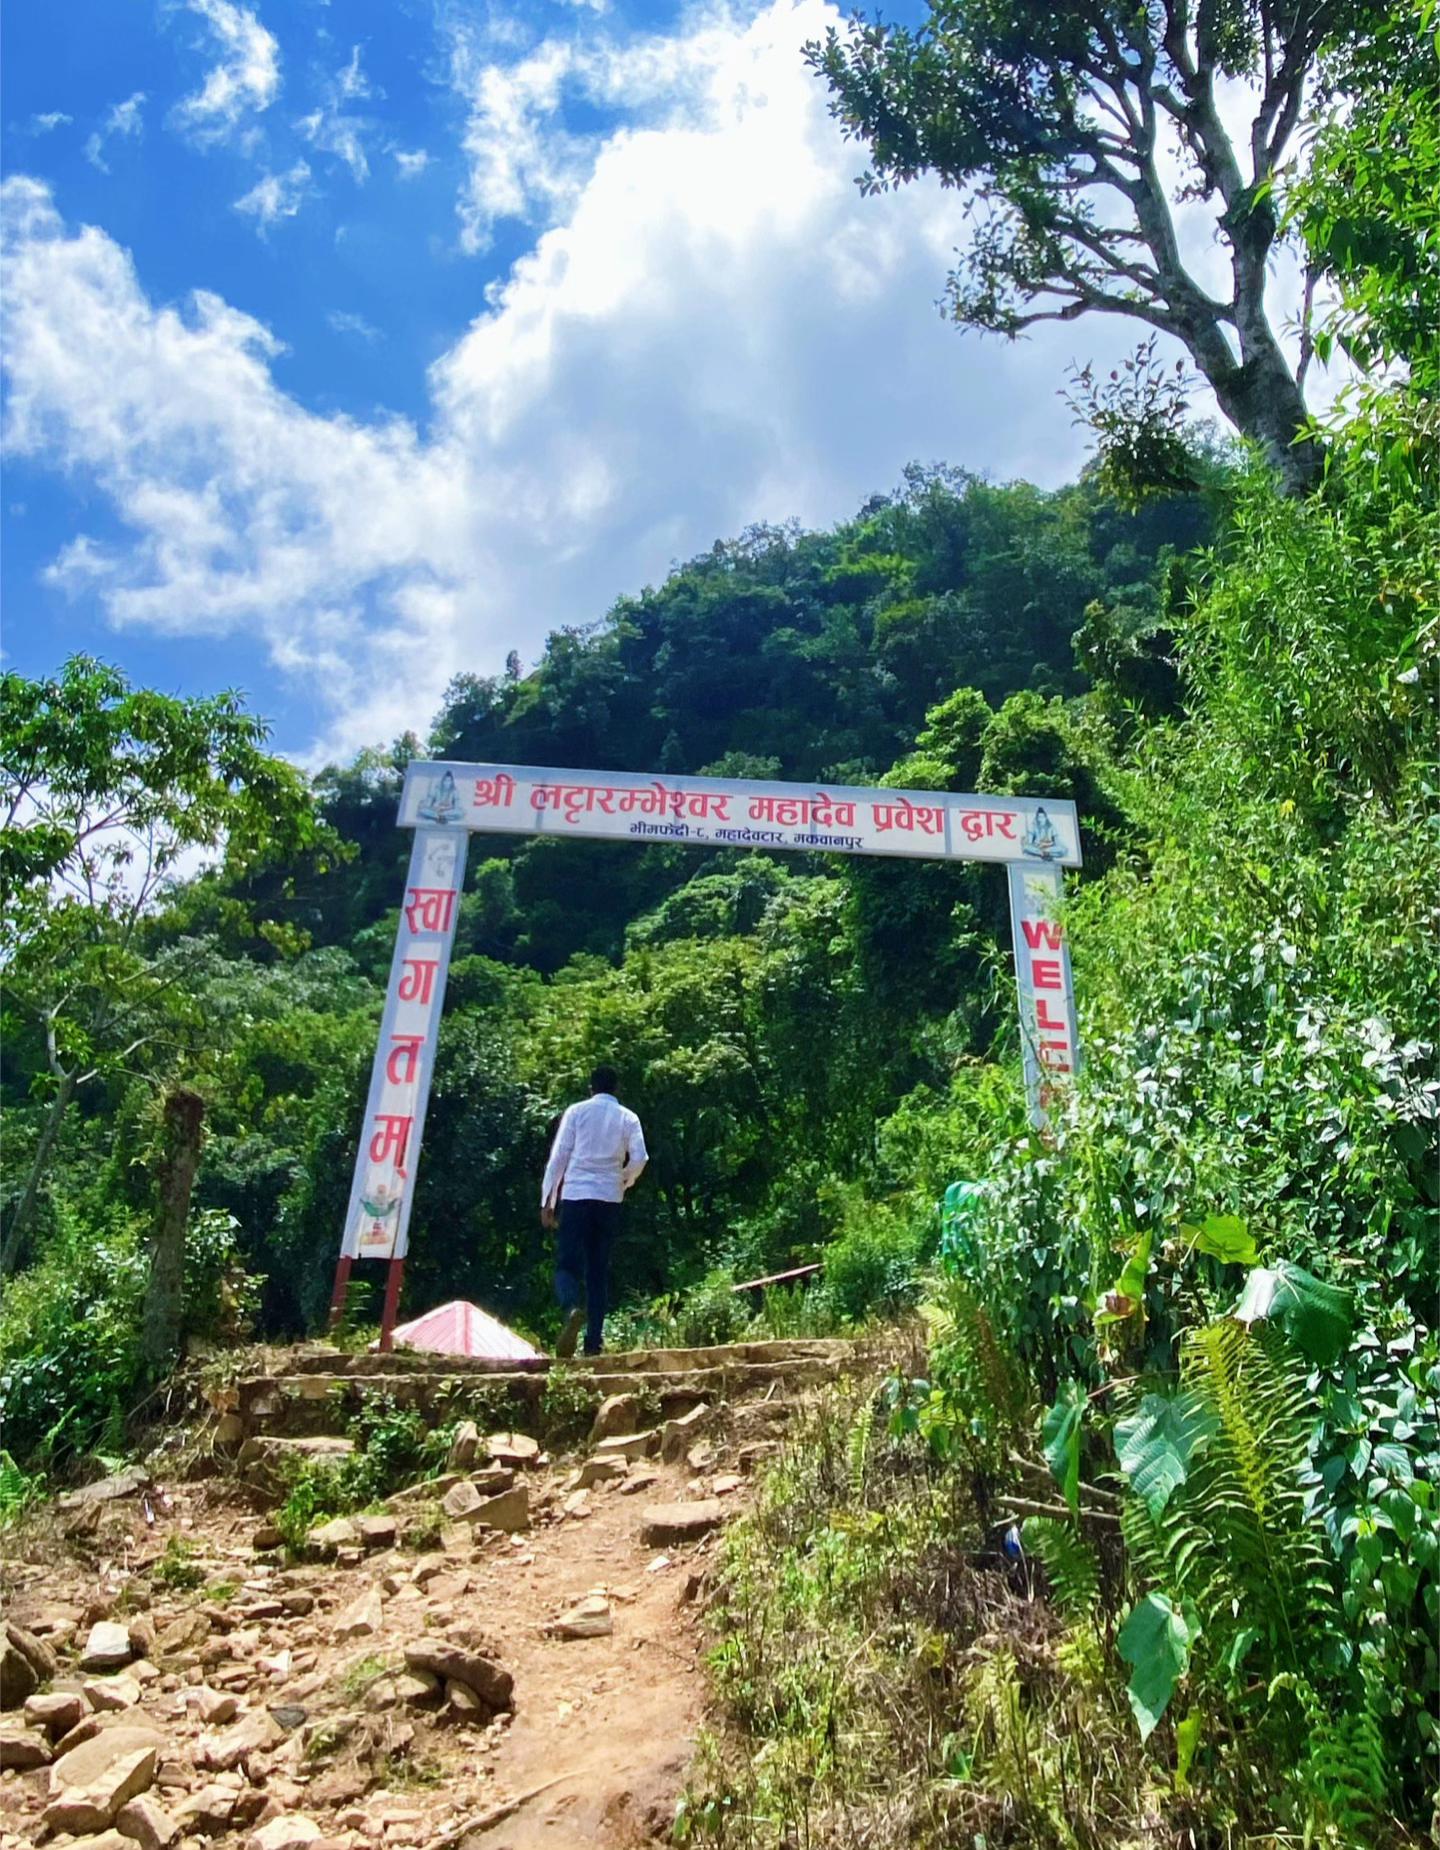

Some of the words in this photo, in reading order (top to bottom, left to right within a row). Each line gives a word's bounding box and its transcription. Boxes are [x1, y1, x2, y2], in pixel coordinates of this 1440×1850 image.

[473, 773, 517, 808] श्री
[748, 792, 856, 828] महादेव
[871, 797, 946, 835] प्रवेश
[960, 808, 1018, 843] द्वार
[793, 833, 864, 850] मकवानपुर
